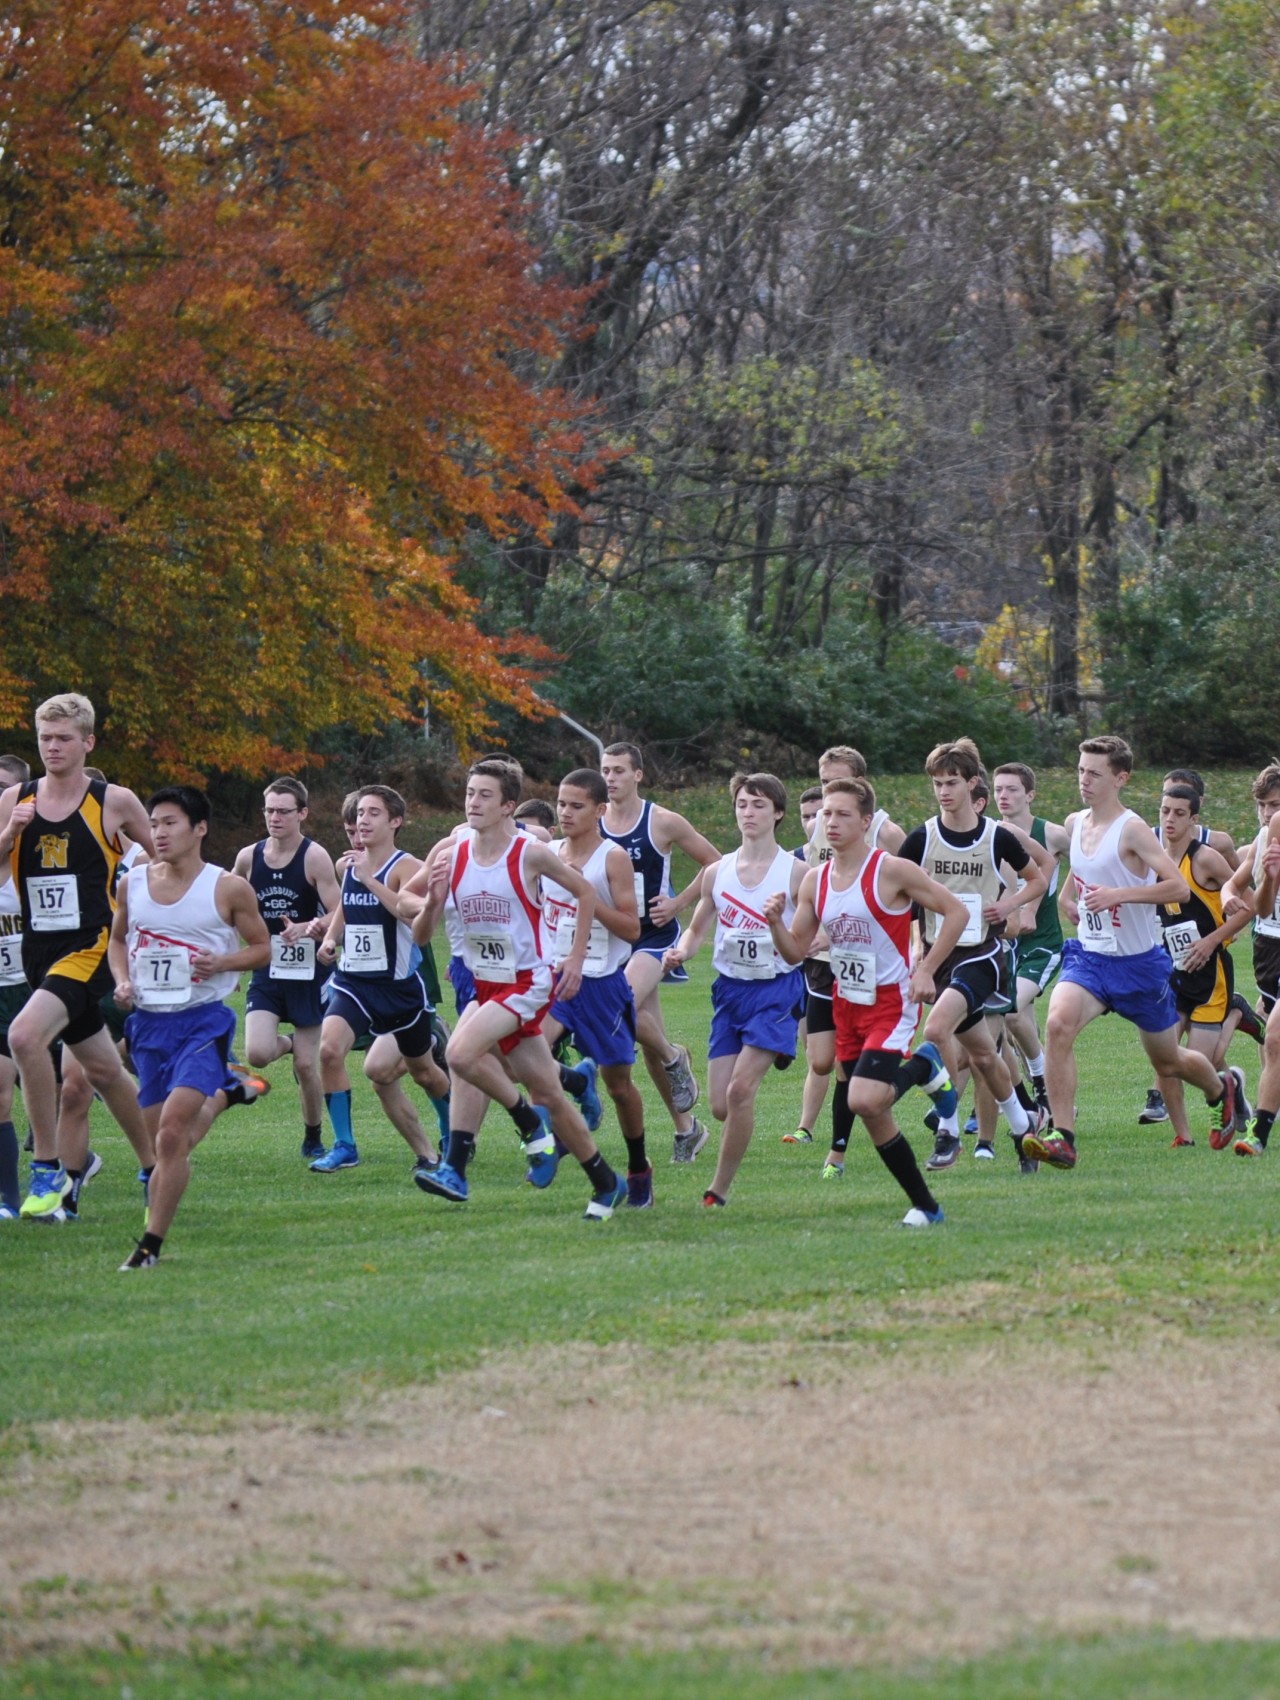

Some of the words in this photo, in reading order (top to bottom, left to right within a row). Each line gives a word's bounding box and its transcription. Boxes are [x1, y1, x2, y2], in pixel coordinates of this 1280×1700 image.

[934, 860, 983, 877] BECAHI
[37, 887, 65, 909] 157
[257, 886, 299, 901] SALISBURY
[343, 893, 379, 906] EAGLES
[461, 898, 511, 919] SAUCON
[722, 905, 739, 923] JIM
[1086, 912, 1102, 931] 80
[280, 945, 305, 962] 238
[355, 935, 371, 953] 26
[477, 942, 505, 961] 240
[737, 940, 757, 959] 78
[150, 960, 171, 981] 77
[839, 960, 865, 983] 242
